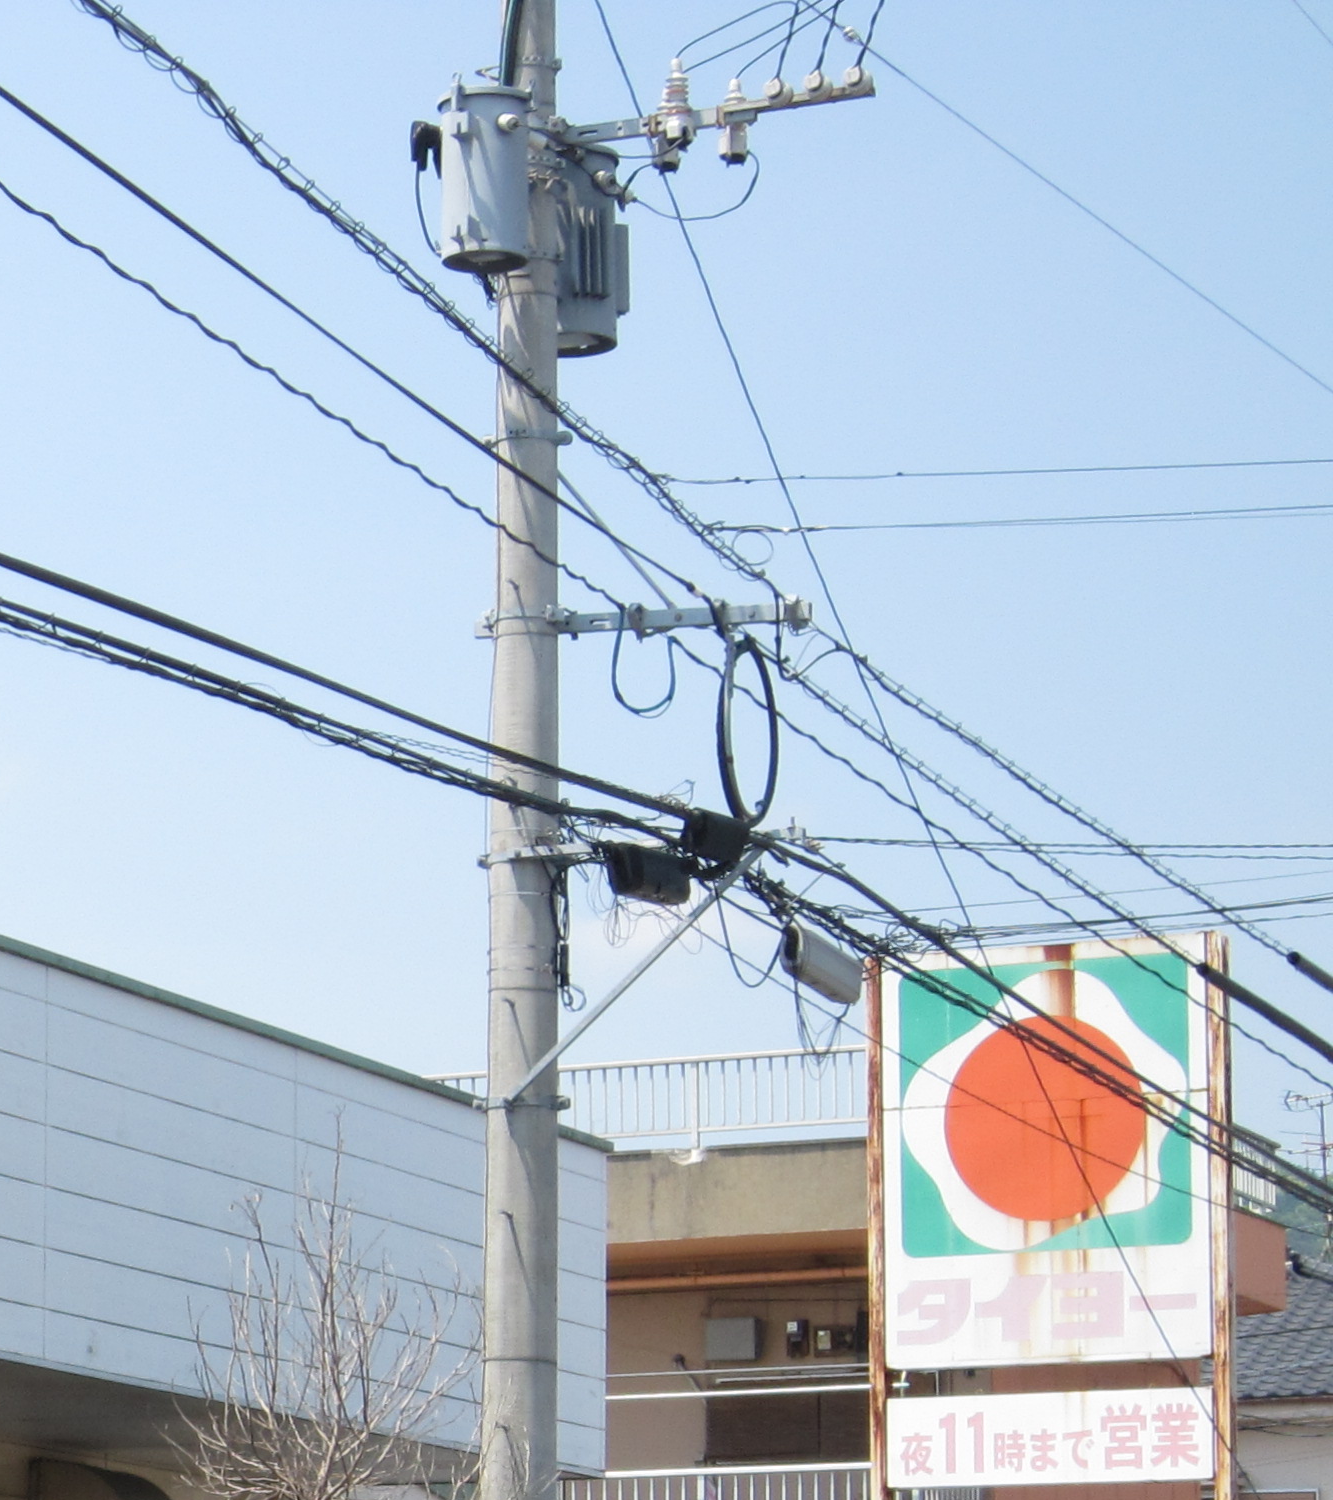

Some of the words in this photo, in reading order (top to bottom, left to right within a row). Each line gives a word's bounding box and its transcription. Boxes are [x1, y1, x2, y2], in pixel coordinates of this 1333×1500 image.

[897, 1270, 1198, 1346] タイヨー
[900, 1402, 1201, 1477] 夜11時まで営業
